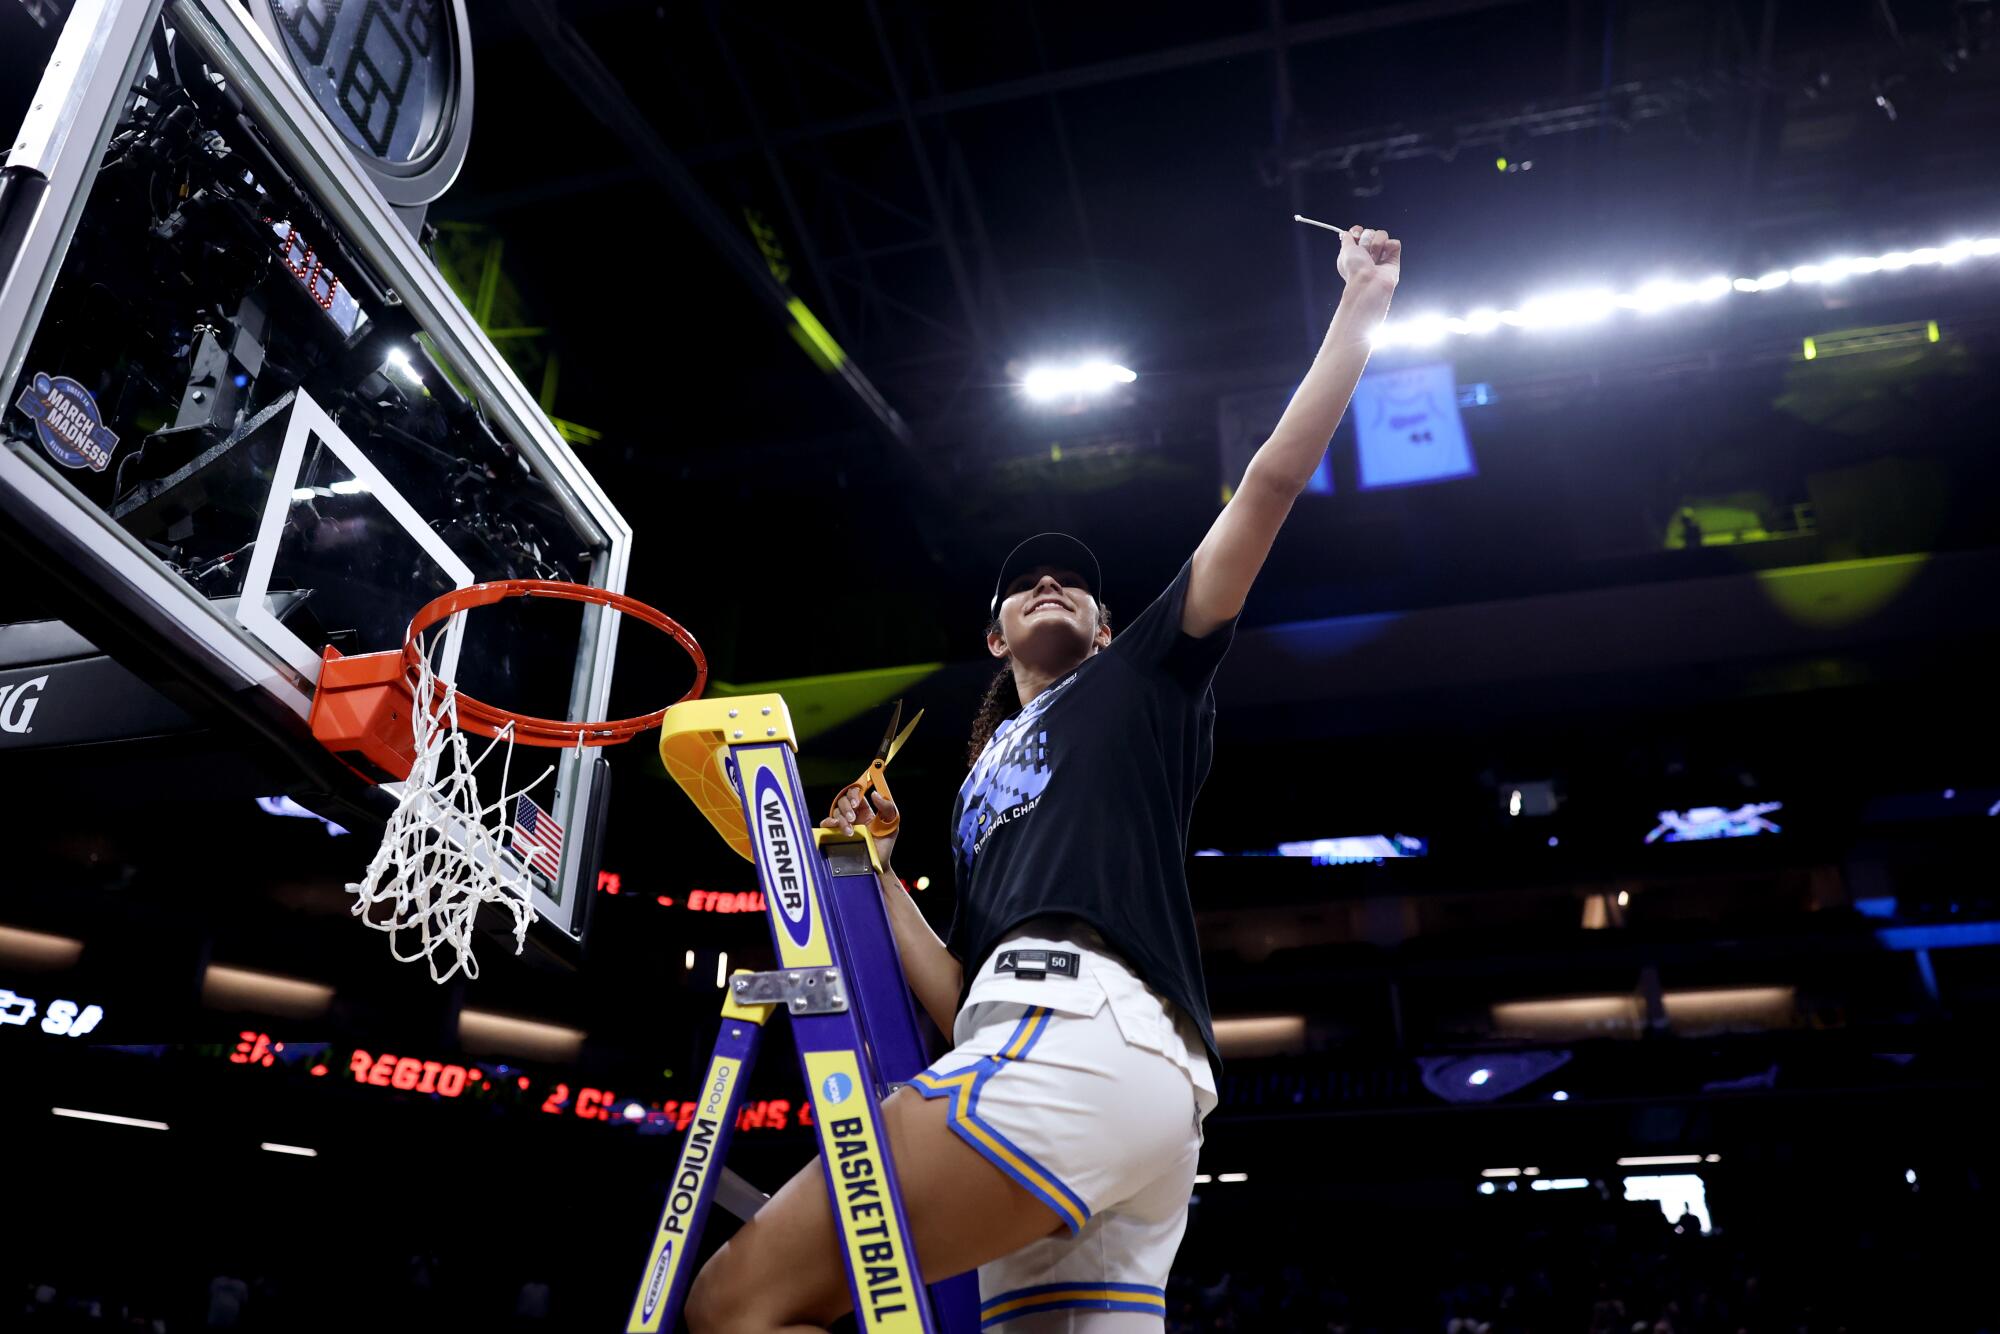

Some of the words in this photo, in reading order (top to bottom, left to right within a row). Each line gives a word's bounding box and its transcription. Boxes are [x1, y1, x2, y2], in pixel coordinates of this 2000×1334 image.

[47, 387, 95, 436] MARCH
[47, 407, 109, 467] MADNESS
[763, 799, 803, 911] WERNER
[1051, 956, 1066, 968] 50
[828, 1076, 841, 1104] NCAA
[645, 1254, 669, 1309] WERNER
[663, 1117, 719, 1235] PODIUM
[706, 1065, 731, 1115] PODIO
[830, 1116, 907, 1323] BASKETBALL
